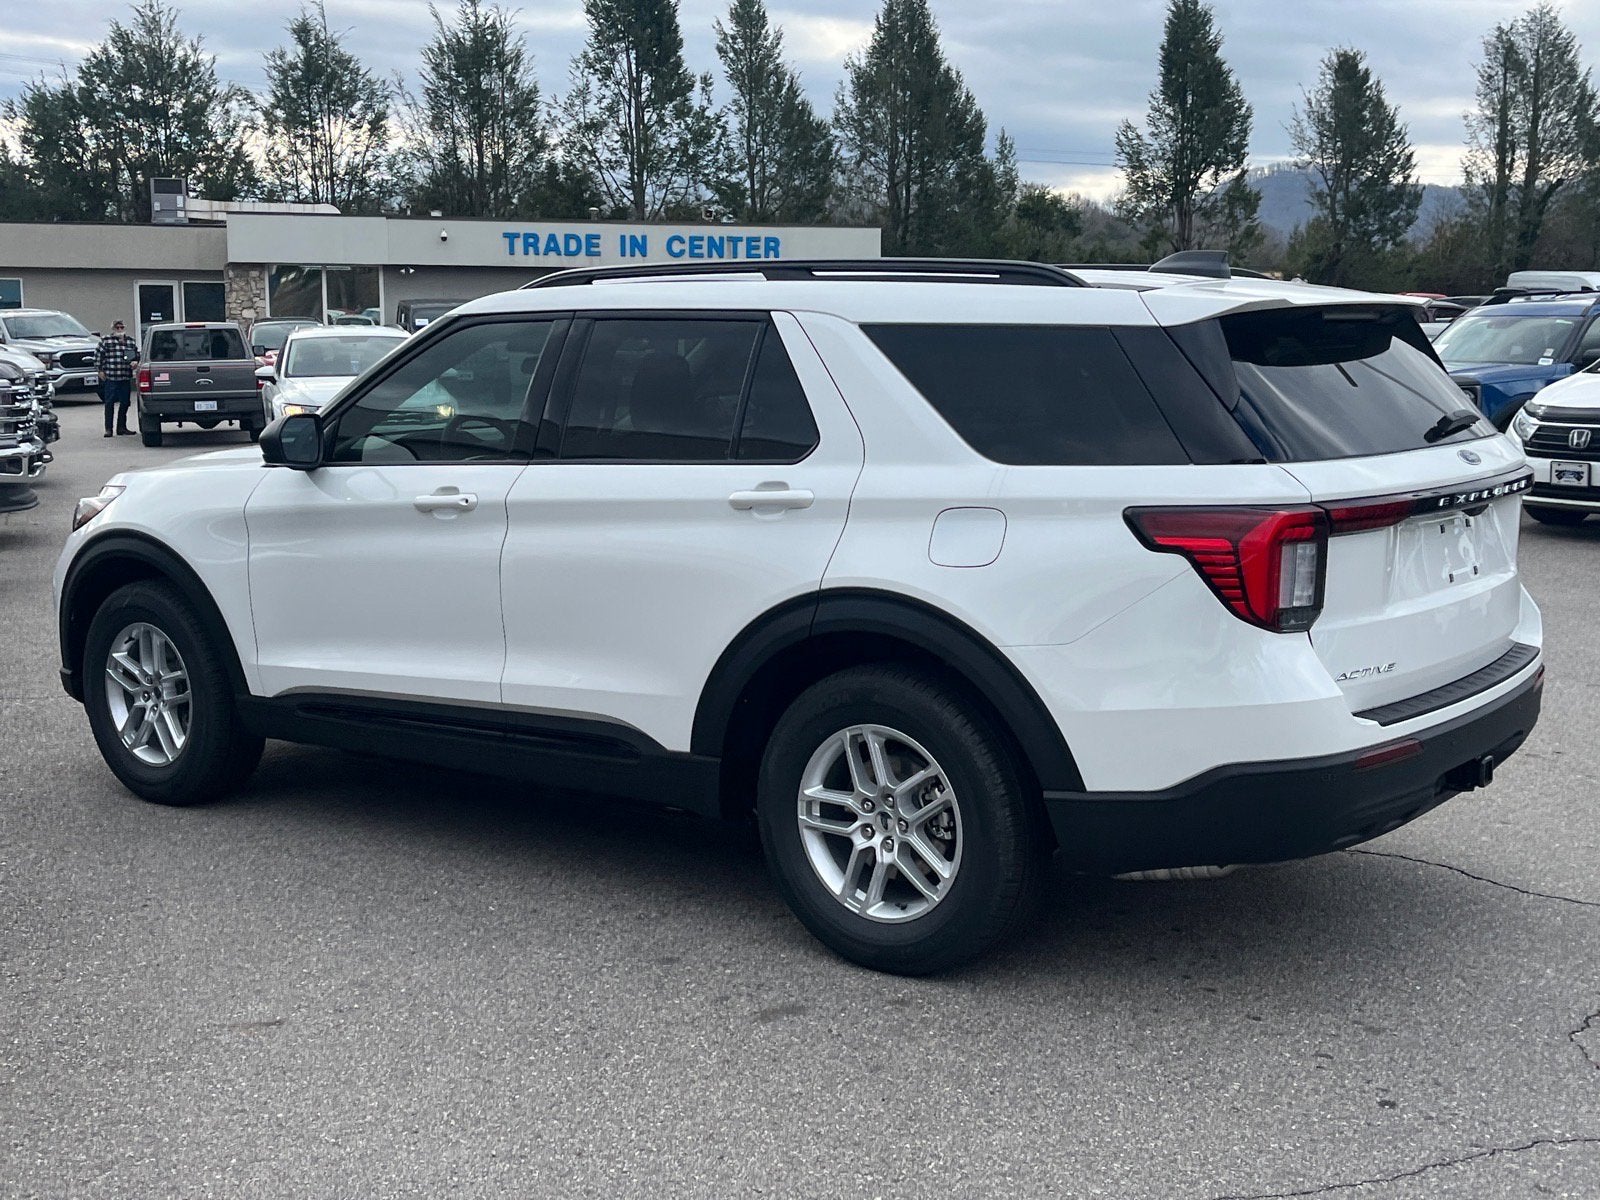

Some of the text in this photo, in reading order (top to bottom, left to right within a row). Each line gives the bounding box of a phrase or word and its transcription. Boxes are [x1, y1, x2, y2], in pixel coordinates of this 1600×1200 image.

[502, 232, 781, 259] TRADE IN CENTER
[1335, 662, 1397, 682] ACTIVE
